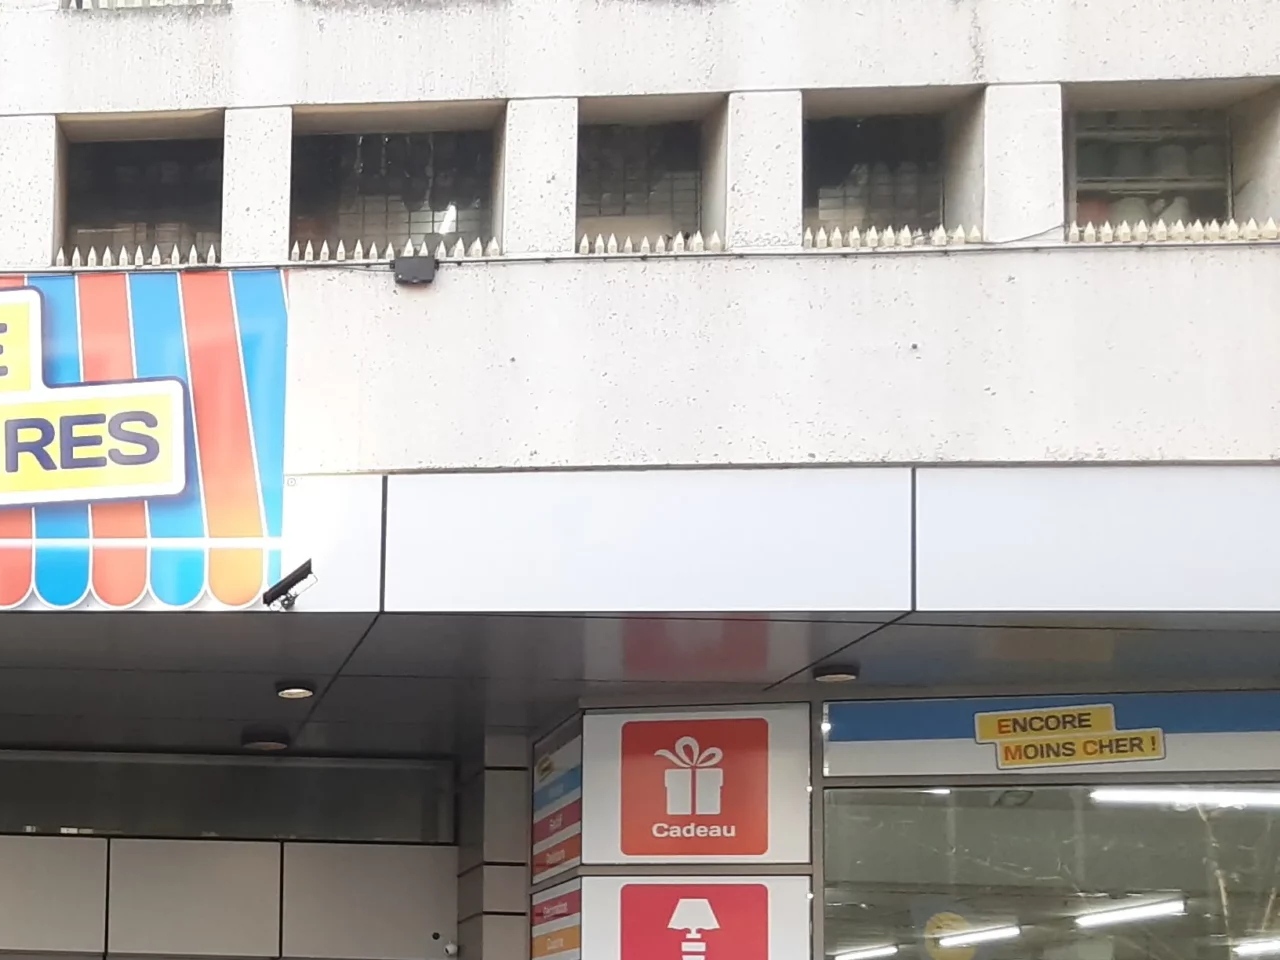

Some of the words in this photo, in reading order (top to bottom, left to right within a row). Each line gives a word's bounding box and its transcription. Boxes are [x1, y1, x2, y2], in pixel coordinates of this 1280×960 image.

[997, 712, 1092, 734] ENCORE
[1004, 741, 1075, 761] MOINS
[1083, 735, 1144, 756] CHER
[652, 823, 736, 837] Cadeau
